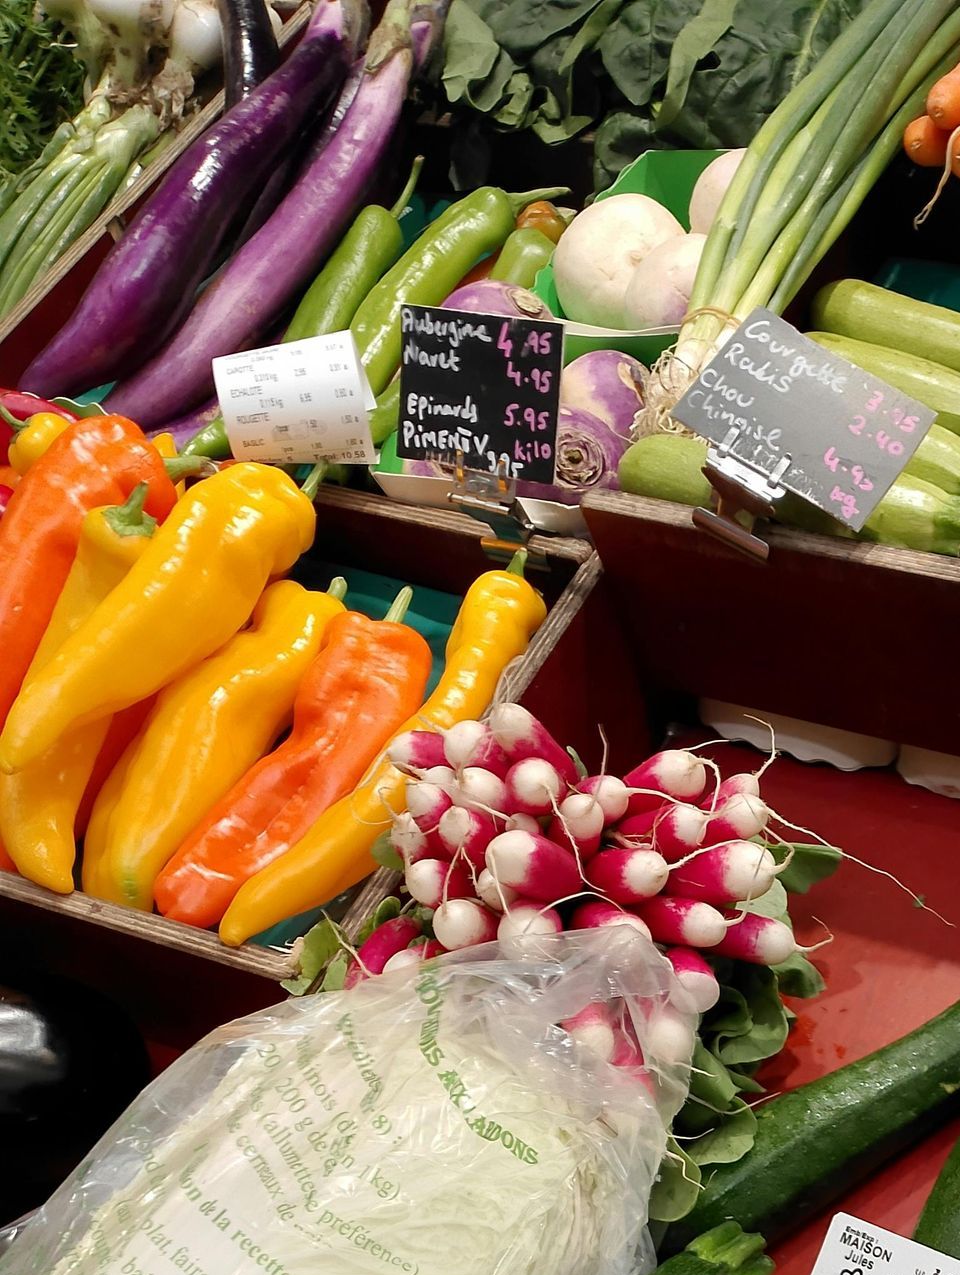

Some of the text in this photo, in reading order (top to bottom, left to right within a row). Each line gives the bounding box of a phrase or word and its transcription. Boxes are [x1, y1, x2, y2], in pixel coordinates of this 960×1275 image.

[401, 307, 493, 348] Aubergine
[744, 320, 850, 394] Courgette
[698, 368, 755, 409] Chou
[503, 403, 550, 432] 5.95
[839, 1232, 893, 1263] MAISON
[844, 1250, 875, 1271] Jules
